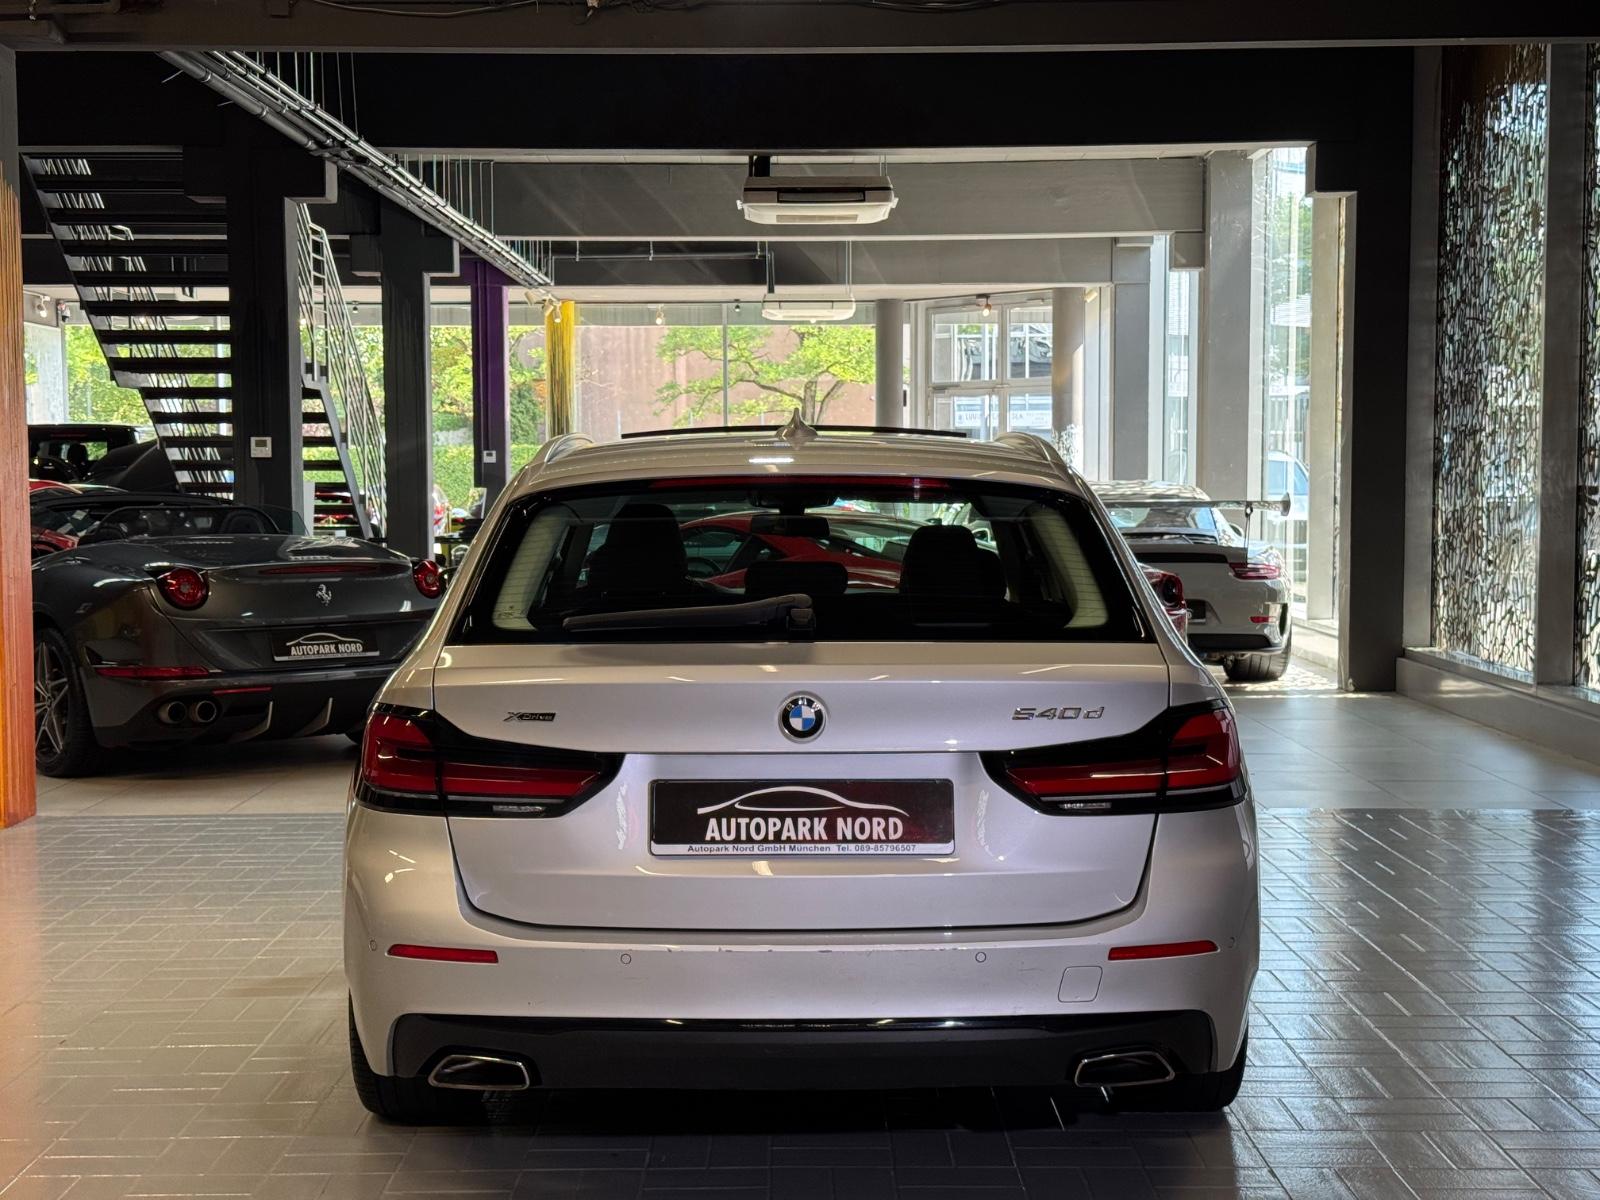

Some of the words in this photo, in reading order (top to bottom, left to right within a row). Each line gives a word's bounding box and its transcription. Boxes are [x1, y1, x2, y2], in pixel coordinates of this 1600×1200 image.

[291, 644, 336, 656] AUTOPARK
[338, 643, 363, 653] NORD
[705, 817, 828, 841] AUTOPARK
[837, 816, 904, 841] NORD
[687, 845, 730, 853] Autopark
[732, 845, 755, 853] Nord
[757, 845, 786, 853] GmbH
[788, 844, 831, 853] München
[836, 844, 852, 852] Tel.
